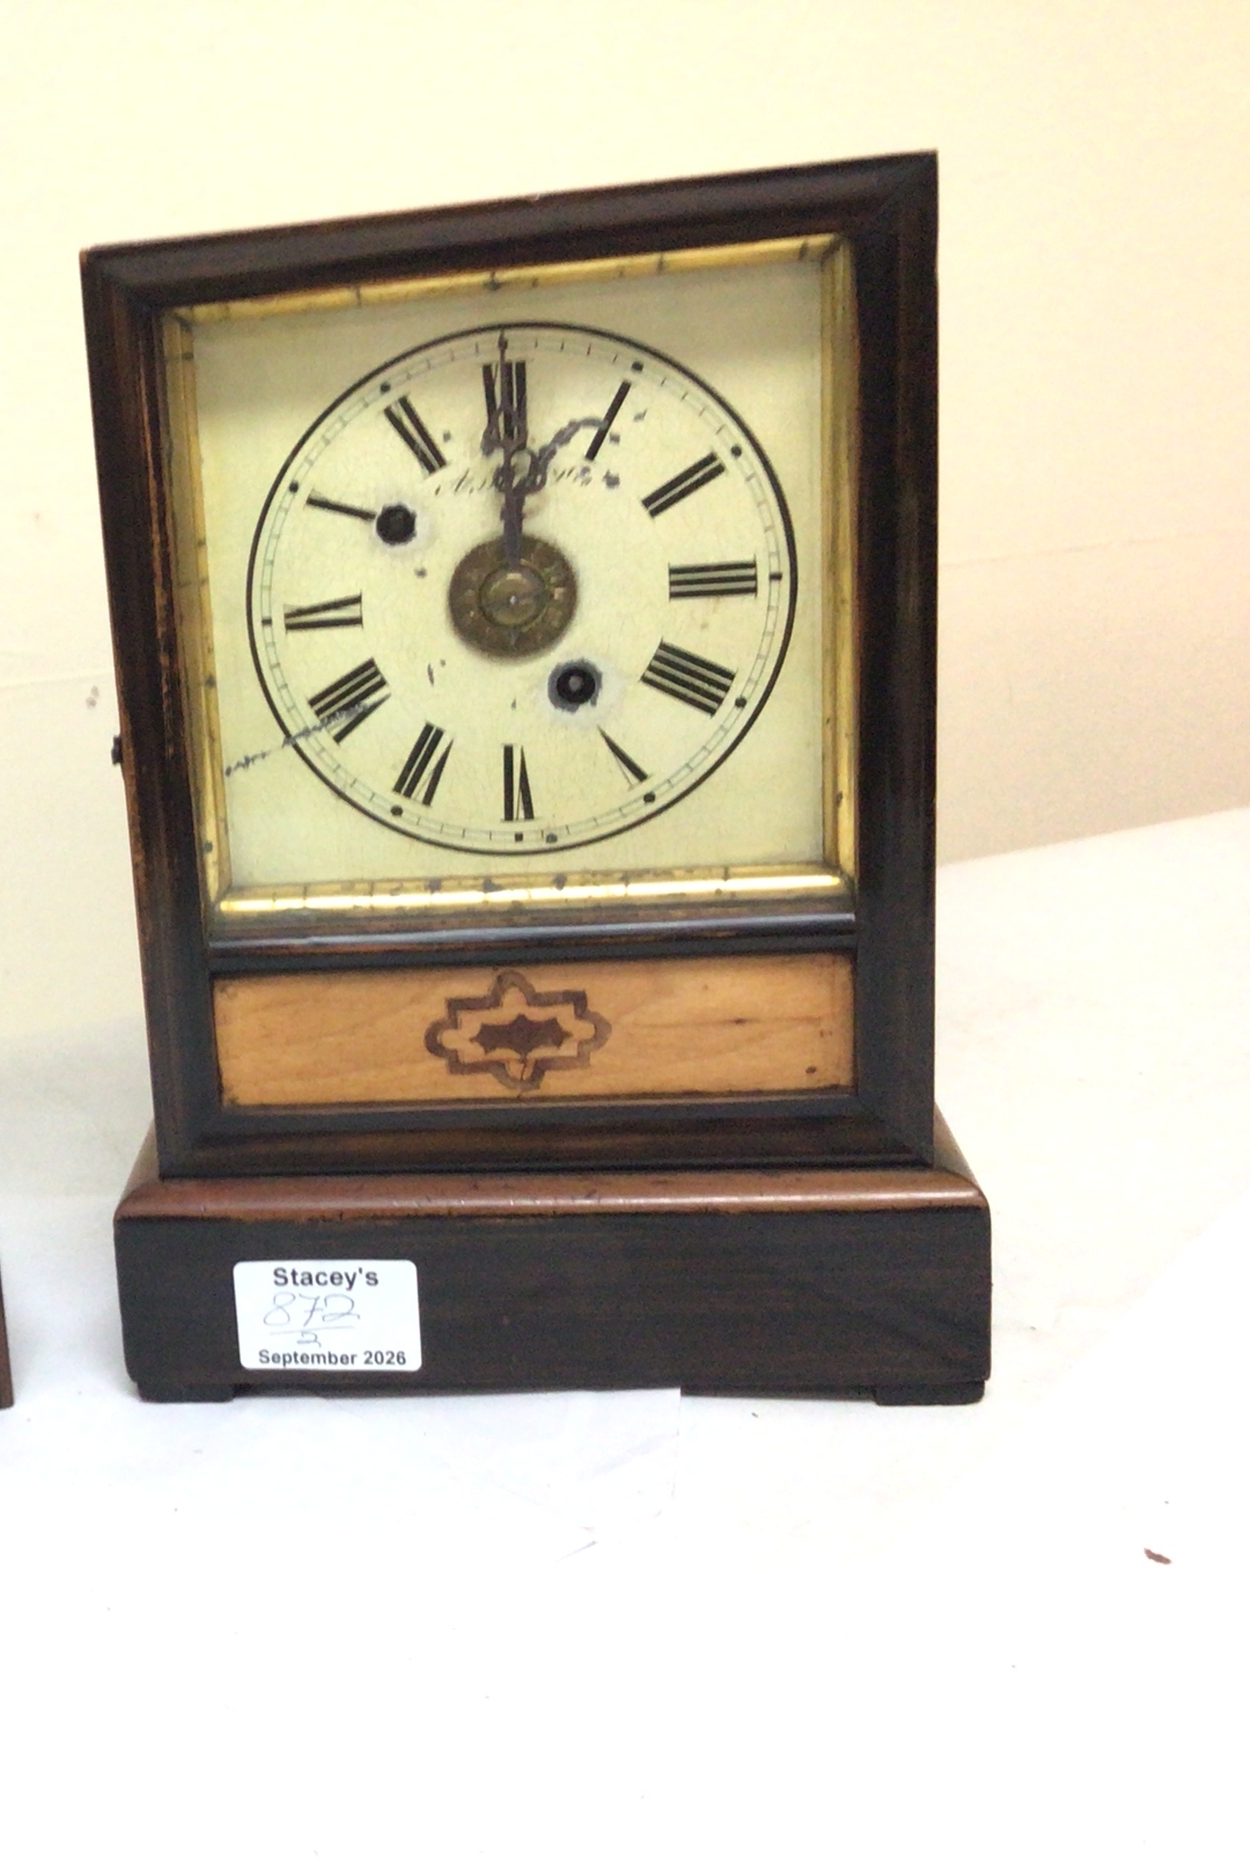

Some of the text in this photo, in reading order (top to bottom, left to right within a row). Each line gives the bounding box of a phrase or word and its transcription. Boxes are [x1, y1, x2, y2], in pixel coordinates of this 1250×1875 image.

[641, 451, 726, 518] II
[668, 556, 758, 599] III
[640, 641, 736, 717] IIII
[273, 1267, 379, 1291] Stacey's
[258, 1349, 407, 1368] September 2026
